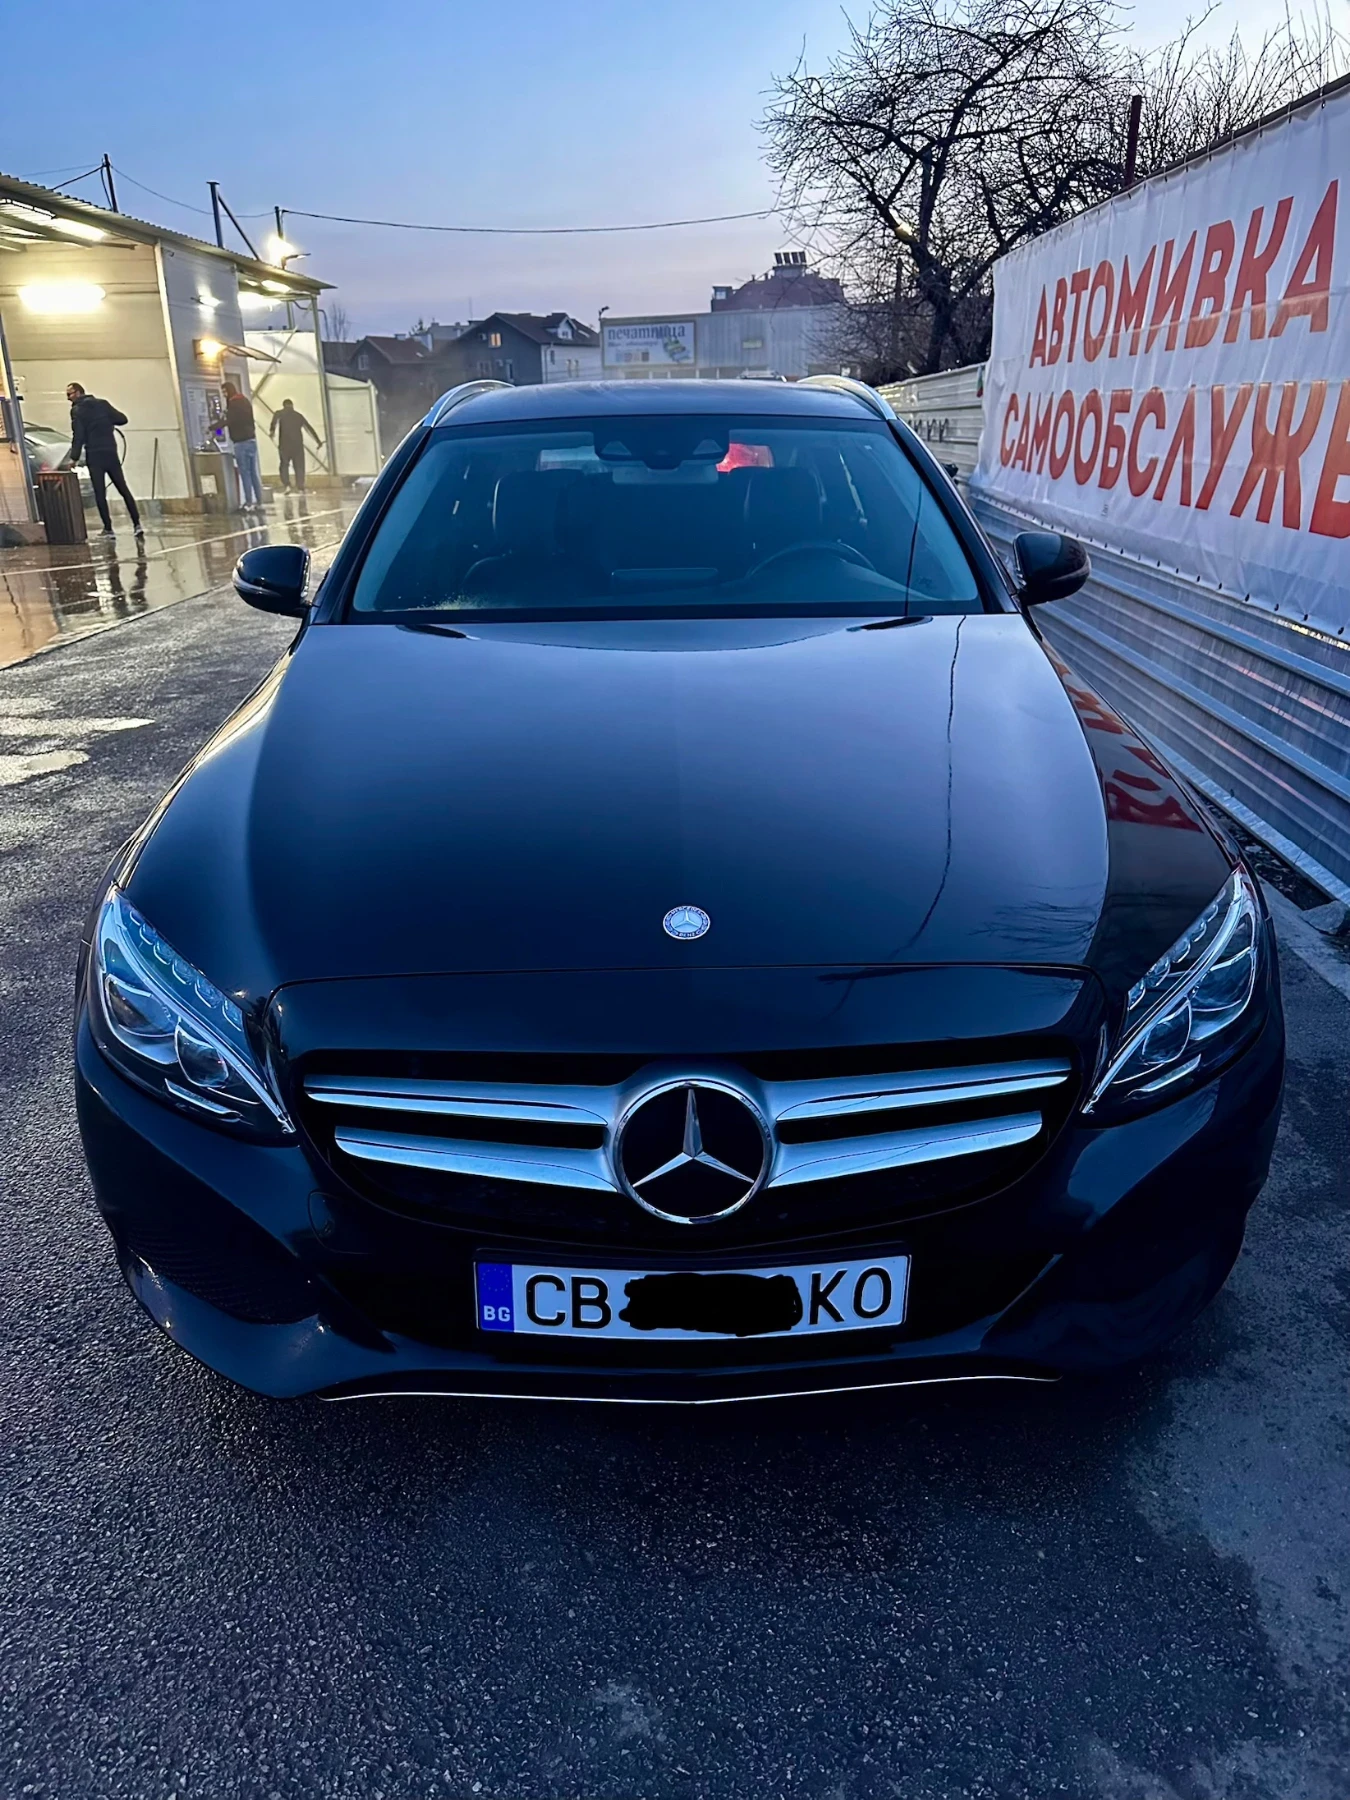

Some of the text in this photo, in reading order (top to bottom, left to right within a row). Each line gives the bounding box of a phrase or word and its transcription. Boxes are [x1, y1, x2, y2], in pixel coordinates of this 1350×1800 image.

[1028, 178, 1338, 369] АВТОМИВКА
[484, 1305, 511, 1322] BG
[526, 1266, 892, 1329] CB KO
